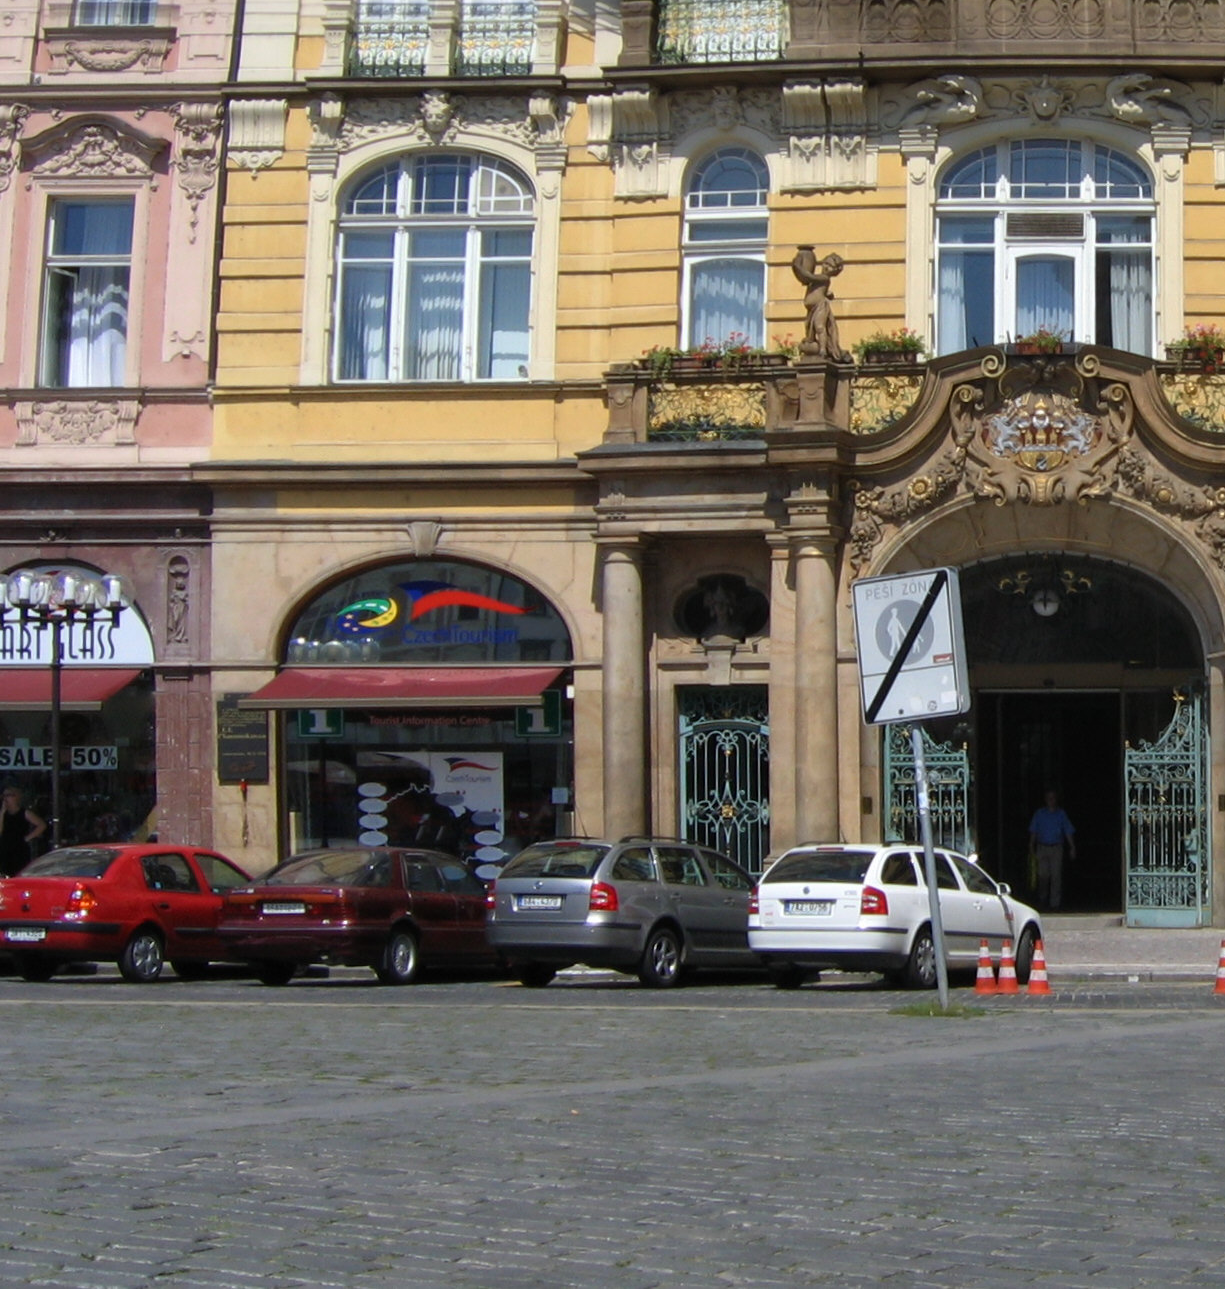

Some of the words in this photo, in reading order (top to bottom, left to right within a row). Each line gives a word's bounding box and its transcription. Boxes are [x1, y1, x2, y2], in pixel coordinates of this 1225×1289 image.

[865, 581, 894, 601] PĚŠÍ
[901, 578, 934, 596] ZÓN
[369, 716, 400, 726] Tourist
[402, 716, 457, 726] Information
[0, 747, 53, 767] SALE
[73, 747, 117, 767] 50%
